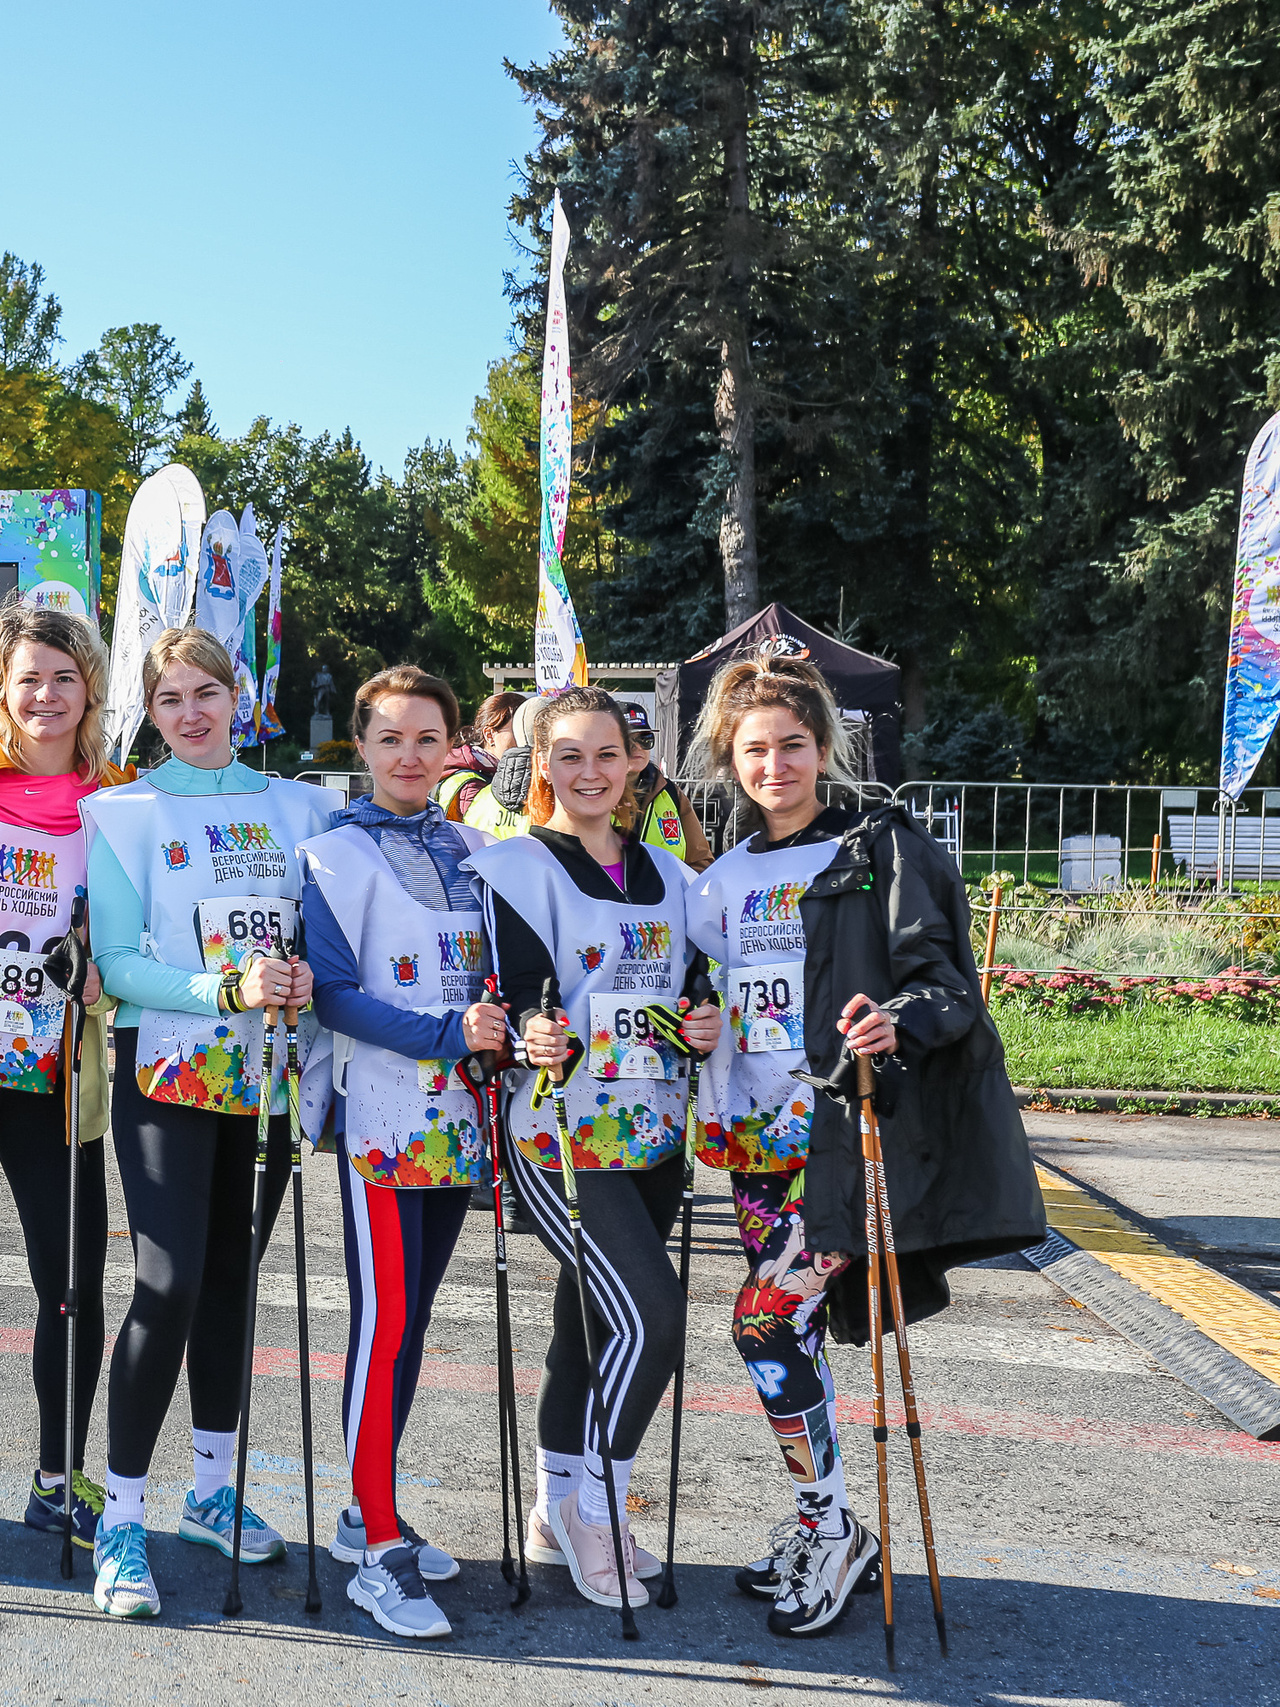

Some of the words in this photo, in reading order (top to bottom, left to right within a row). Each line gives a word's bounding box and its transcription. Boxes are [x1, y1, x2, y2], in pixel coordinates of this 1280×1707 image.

[211, 851, 287, 868] ВСЕРОССИЙСКИЙ
[214, 866, 244, 884] ДЕНЬ
[247, 863, 287, 879] ХОДЬБЫ
[11, 900, 57, 917] ХОДЬБЫ
[228, 910, 282, 941] 685
[740, 938, 766, 956] ДЕНЬ
[442, 988, 465, 1004] ДЕНЬ
[612, 976, 637, 991] ДЕНЬ
[739, 978, 791, 1013] 730
[614, 1008, 666, 1040] 69
[864, 1158, 876, 1203] NORDIC
[875, 1161, 890, 1210] WALKING
[865, 1203, 878, 1255] WALKING
[881, 1211, 896, 1253] NORDIC
